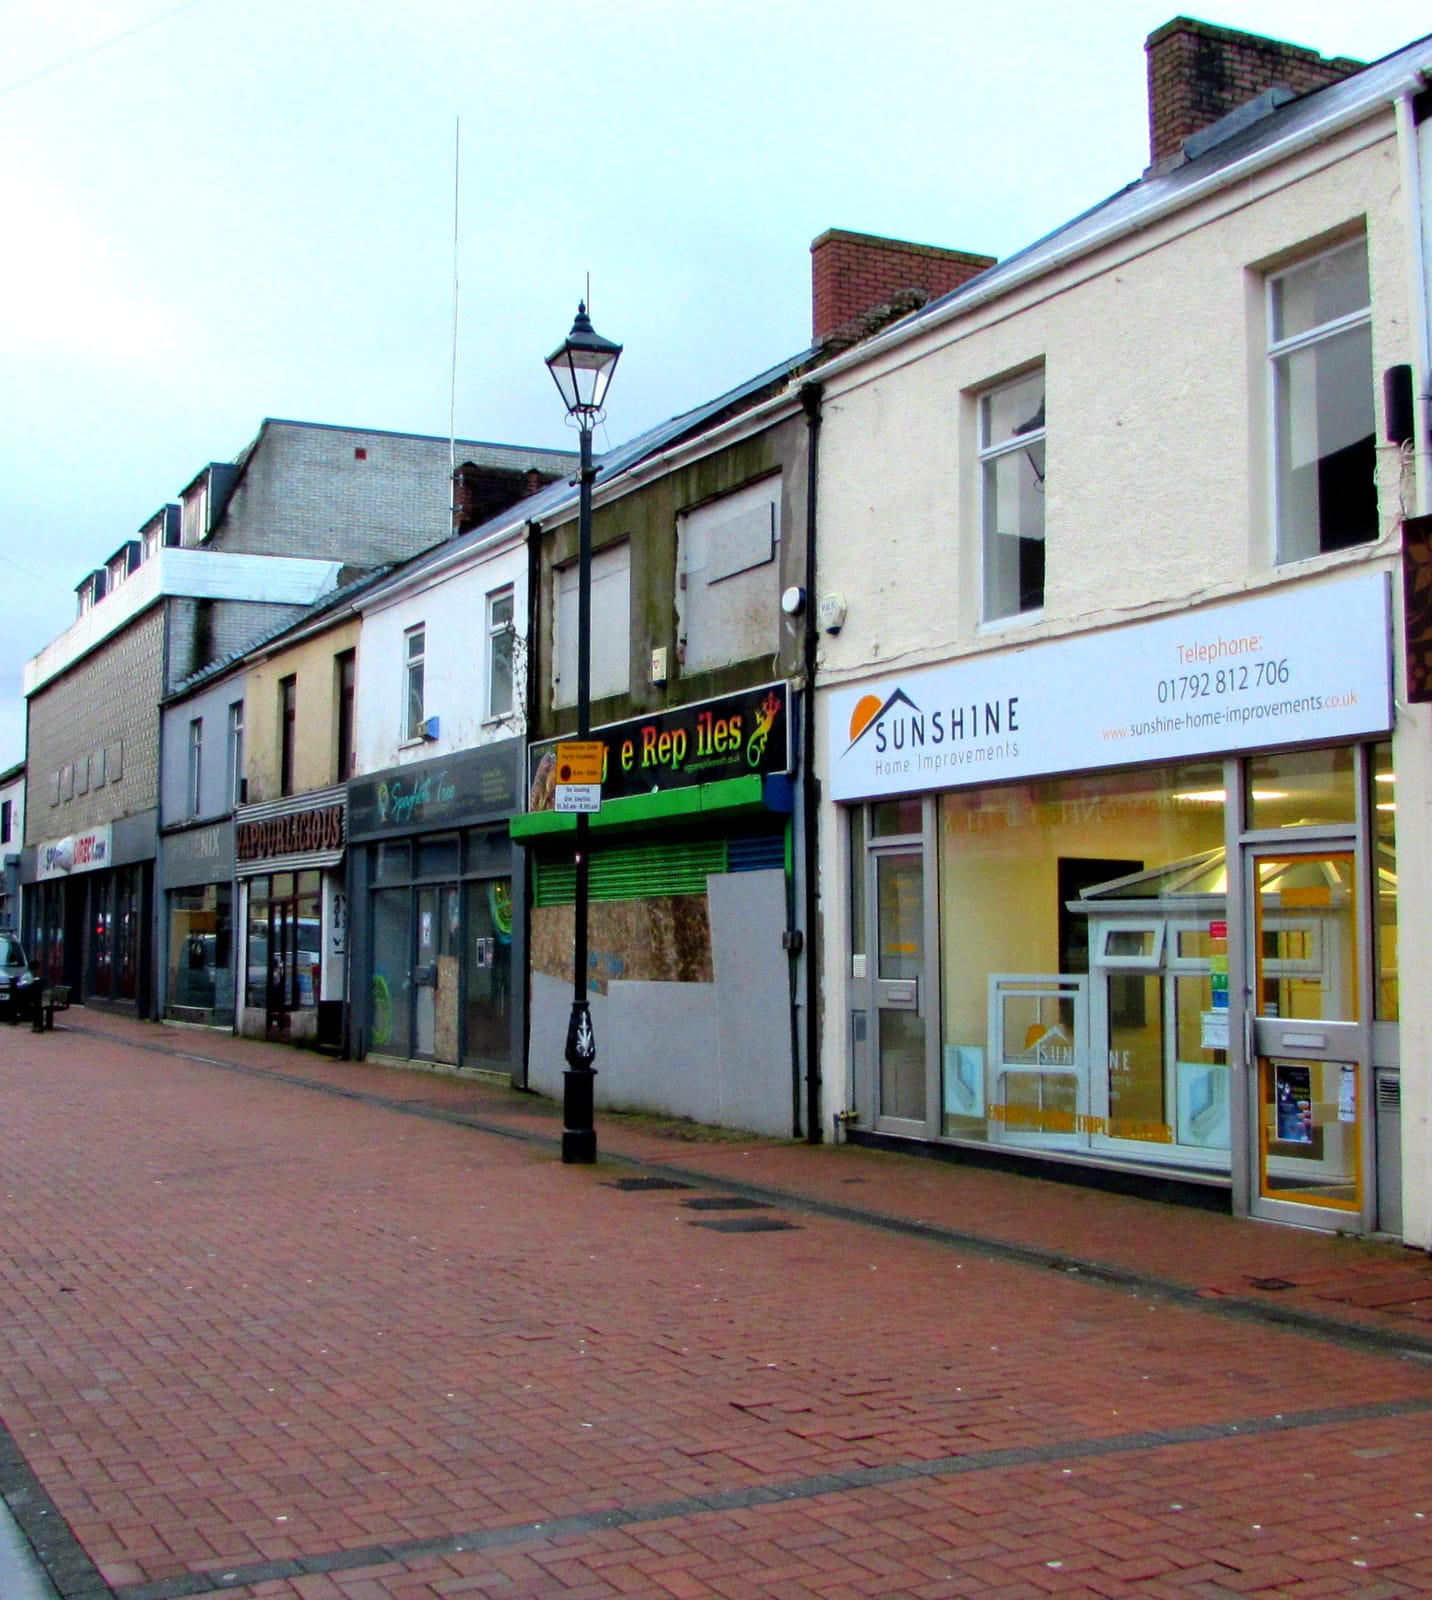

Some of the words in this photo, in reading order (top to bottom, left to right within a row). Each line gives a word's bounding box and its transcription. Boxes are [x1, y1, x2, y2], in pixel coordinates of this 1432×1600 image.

[1176, 633, 1262, 664] Telephone:
[1157, 672, 1210, 703] 01792
[1215, 665, 1248, 694] 812
[1255, 658, 1289, 687] 706
[875, 697, 1019, 753] SUNSHINE
[1102, 690, 1358, 740] www.sunshine-home-improvements.co.uk
[875, 760, 910, 777] Home
[917, 741, 1019, 774] Improvements
